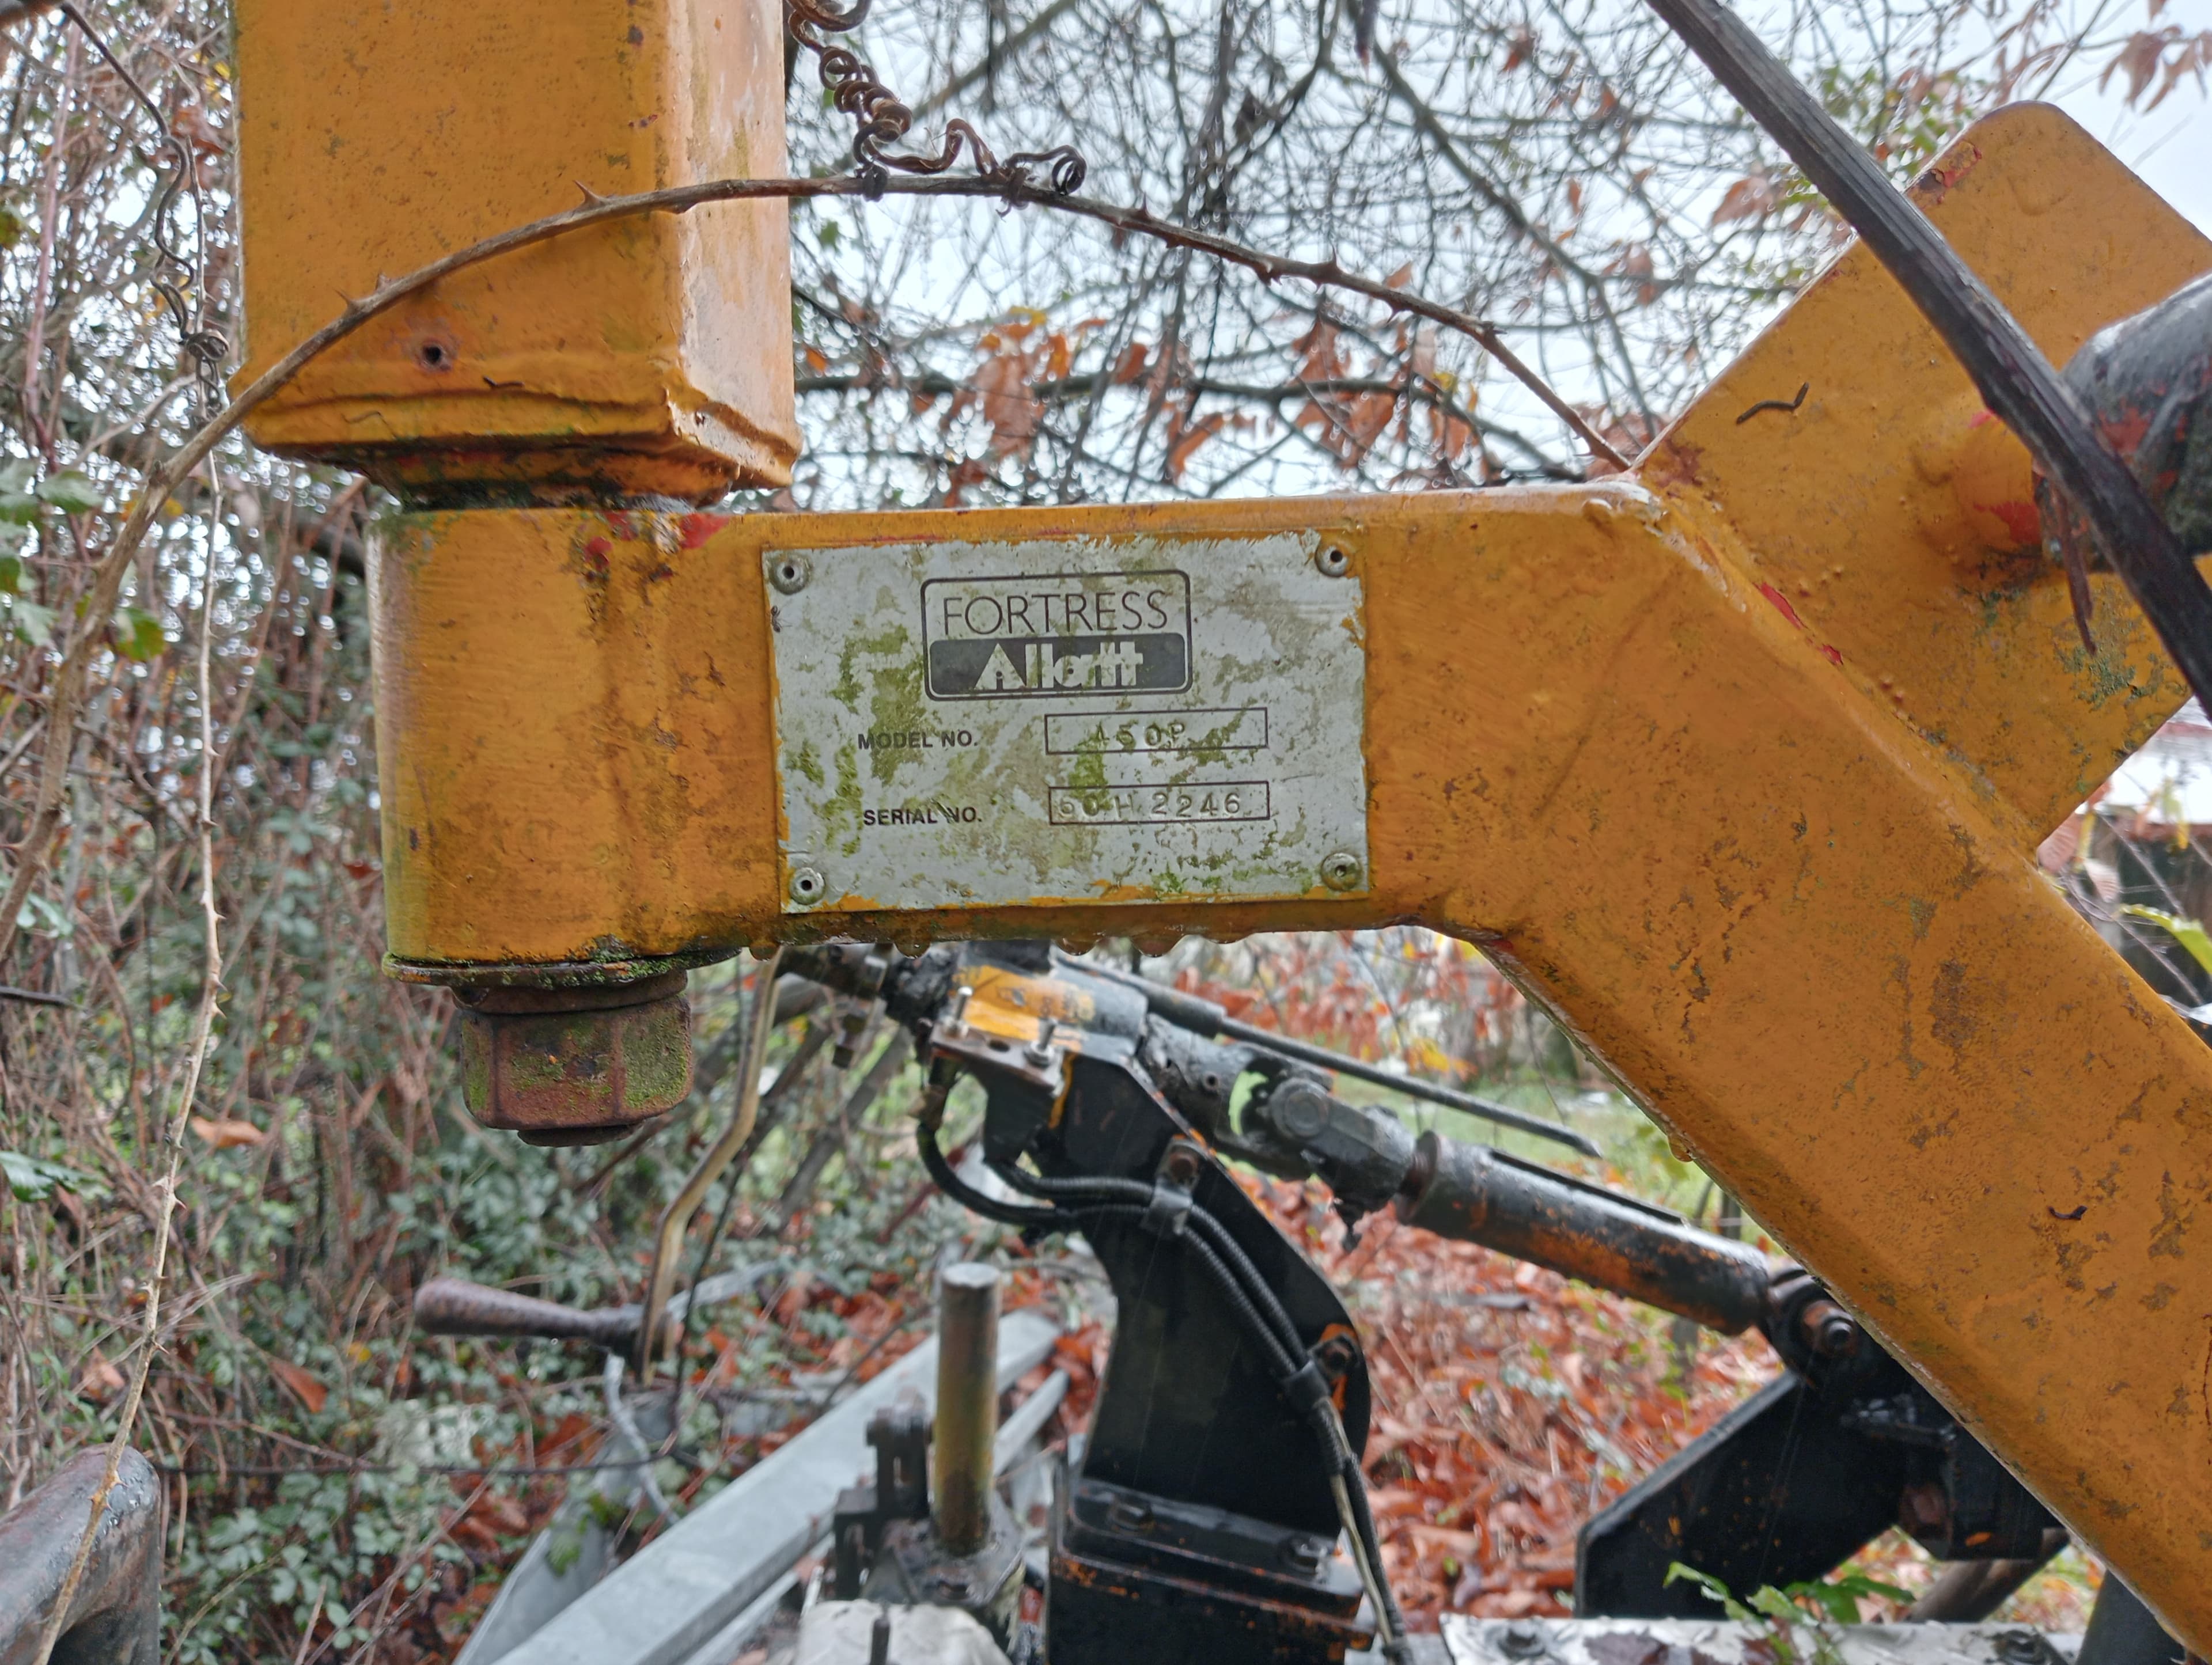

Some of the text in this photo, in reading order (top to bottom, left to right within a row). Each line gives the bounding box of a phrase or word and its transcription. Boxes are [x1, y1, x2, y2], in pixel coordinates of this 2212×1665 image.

[943, 590, 1168, 635] FORTRESS
[858, 731, 933, 749] MODEL
[941, 730, 979, 748] NO.
[863, 809, 938, 826] SERIAL
[946, 806, 982, 824] NO.
[1152, 791, 1241, 818] 2246
